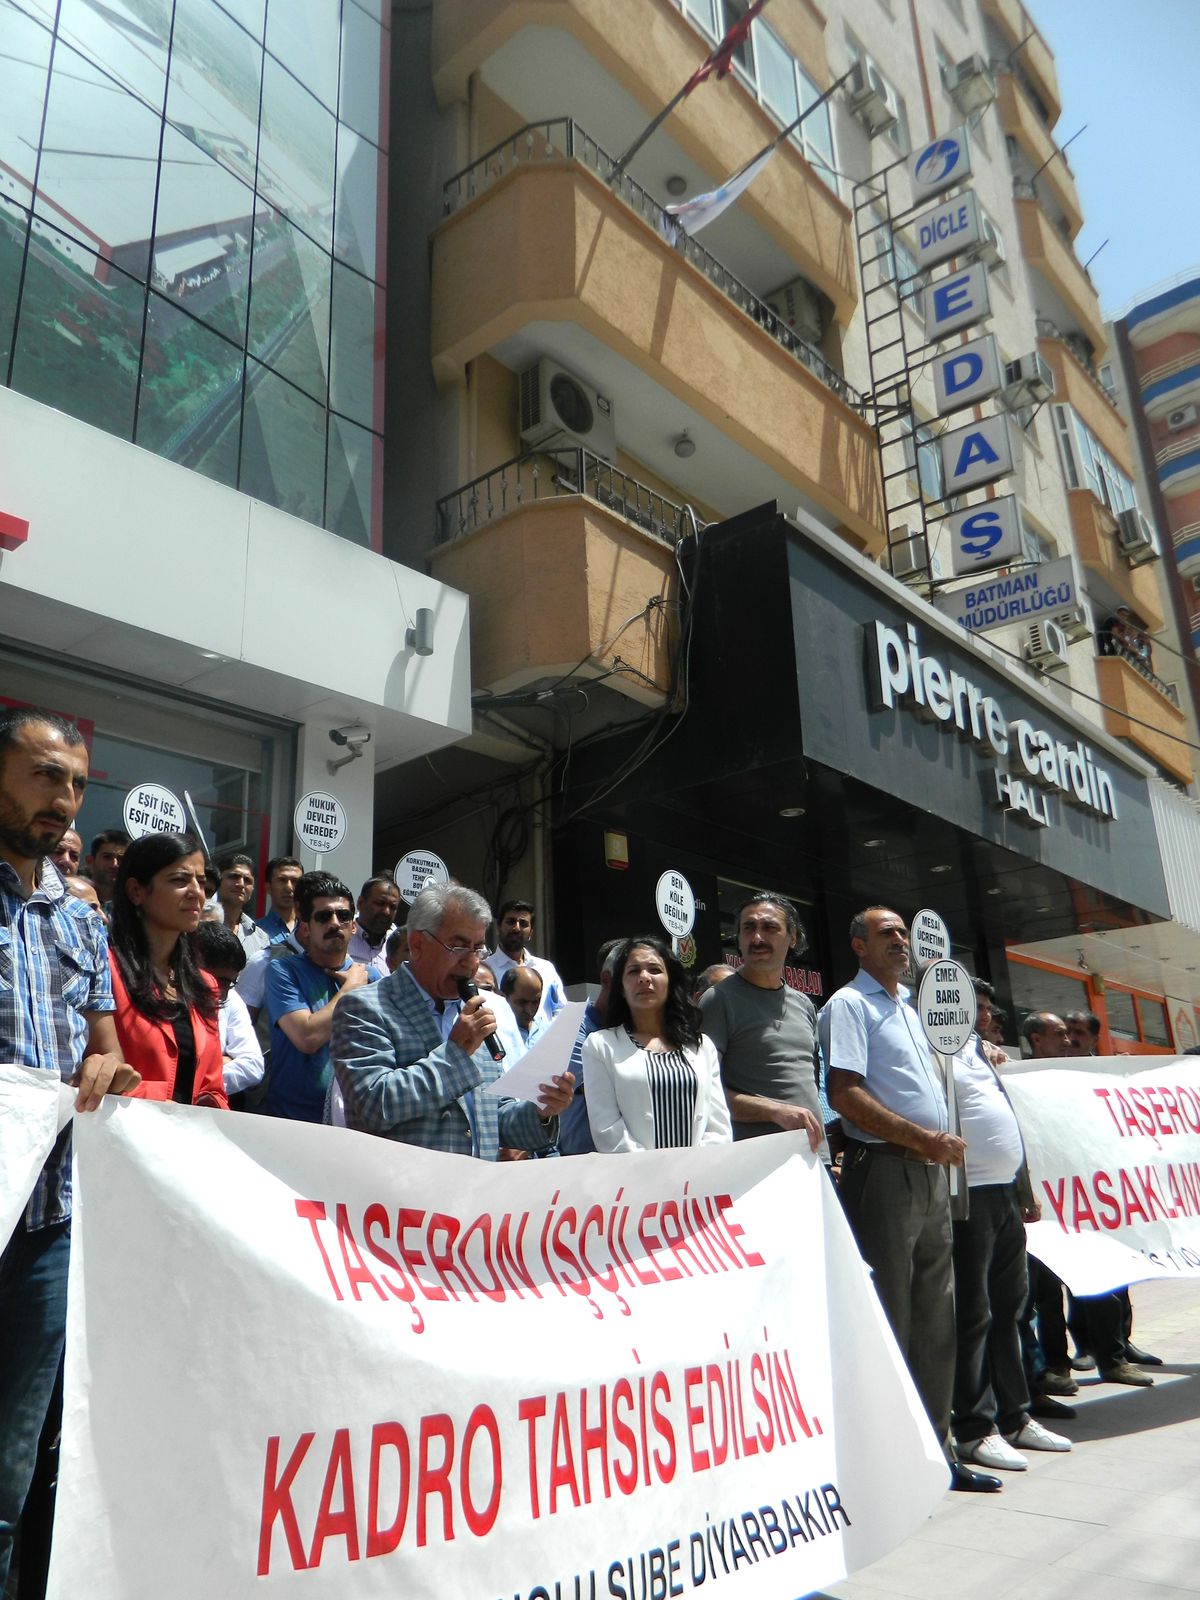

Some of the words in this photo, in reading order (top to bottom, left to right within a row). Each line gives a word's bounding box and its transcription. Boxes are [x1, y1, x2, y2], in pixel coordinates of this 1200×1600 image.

[919, 206, 968, 250] DİCLE
[965, 573, 1038, 609] BATMAN
[957, 582, 1071, 629] MÜDÜRLÜĞÜ
[874, 619, 1008, 756] pierre
[1008, 719, 1118, 821] cardin
[138, 792, 158, 810] EŞİT
[160, 798, 177, 819] İŞE,
[309, 797, 336, 812] HUKUK
[994, 769, 1050, 828] HALI
[129, 807, 150, 826] EŞİT
[306, 810, 337, 826] DEVLETİ
[302, 823, 338, 840] NEREDE?
[671, 876, 683, 891] BEN
[669, 891, 684, 907] KÖLE
[664, 903, 688, 924] DEĞİLİM
[935, 967, 958, 983] EMEK
[936, 989, 960, 1005] BARIŞ
[927, 1008, 970, 1027] ÖZGÜRLÜK
[1041, 1162, 1200, 1234] YASAKLAN
[294, 1198, 545, 1334] TAŞERON
[540, 1181, 766, 1320] İŞÇİLERİNE
[257, 1405, 503, 1576] KADRO
[519, 1348, 678, 1519] TAHSİS
[684, 1326, 823, 1474] EDİLSİN.
[690, 1482, 852, 1588] DİYARBAKIR
